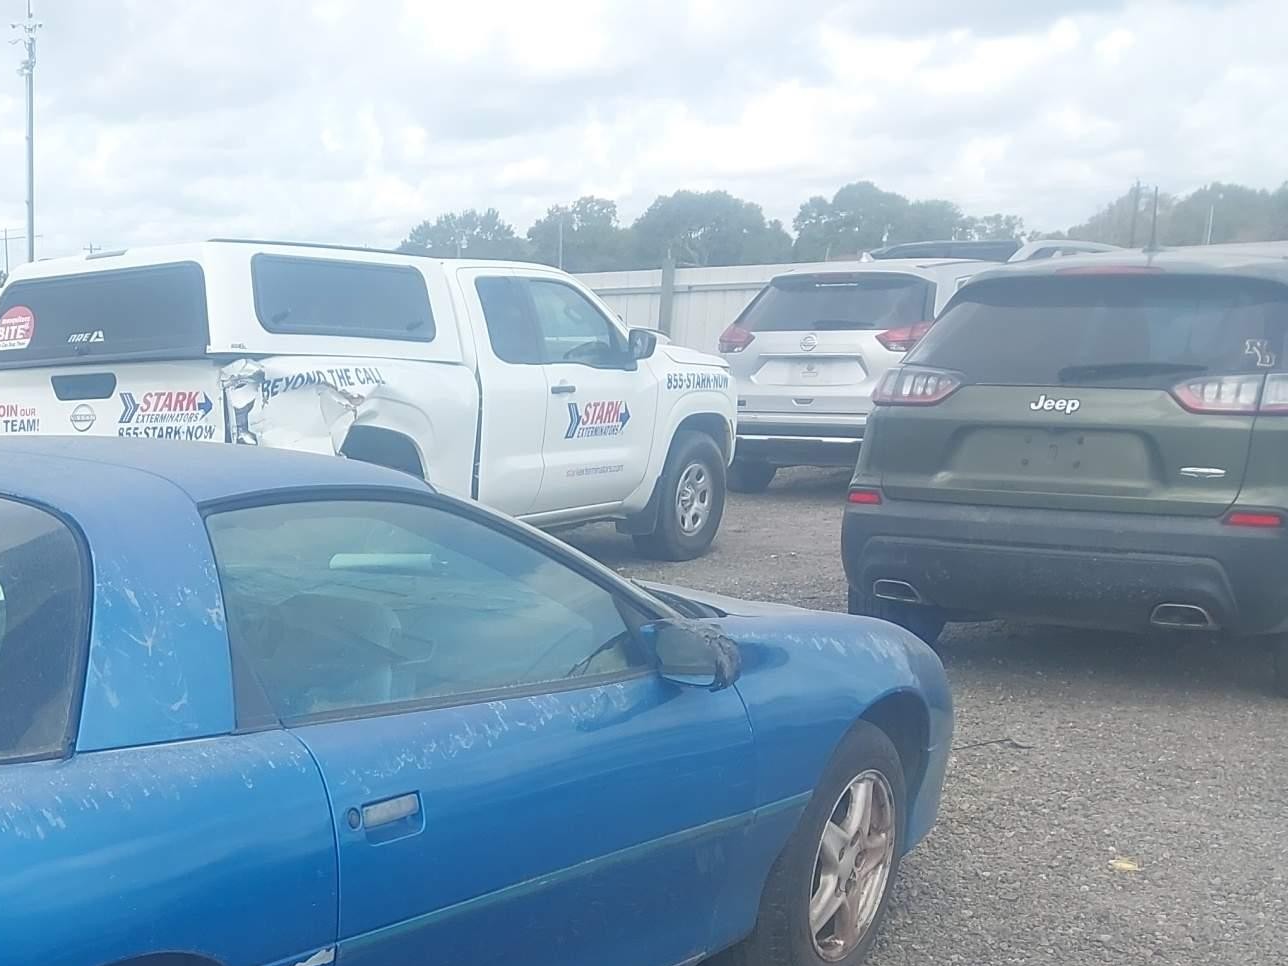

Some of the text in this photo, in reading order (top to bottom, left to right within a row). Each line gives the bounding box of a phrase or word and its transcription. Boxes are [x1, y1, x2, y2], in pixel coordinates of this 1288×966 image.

[262, 367, 387, 399] BEYOND THE CALL
[140, 391, 200, 413] STARK
[1030, 394, 1081, 415] Jeep
[19, 408, 36, 417] OUR
[135, 412, 201, 424] EXTERMINATORS
[581, 400, 623, 425] STARK
[3, 419, 40, 433] TEAM!
[576, 424, 620, 439] EXTERMINATORS
